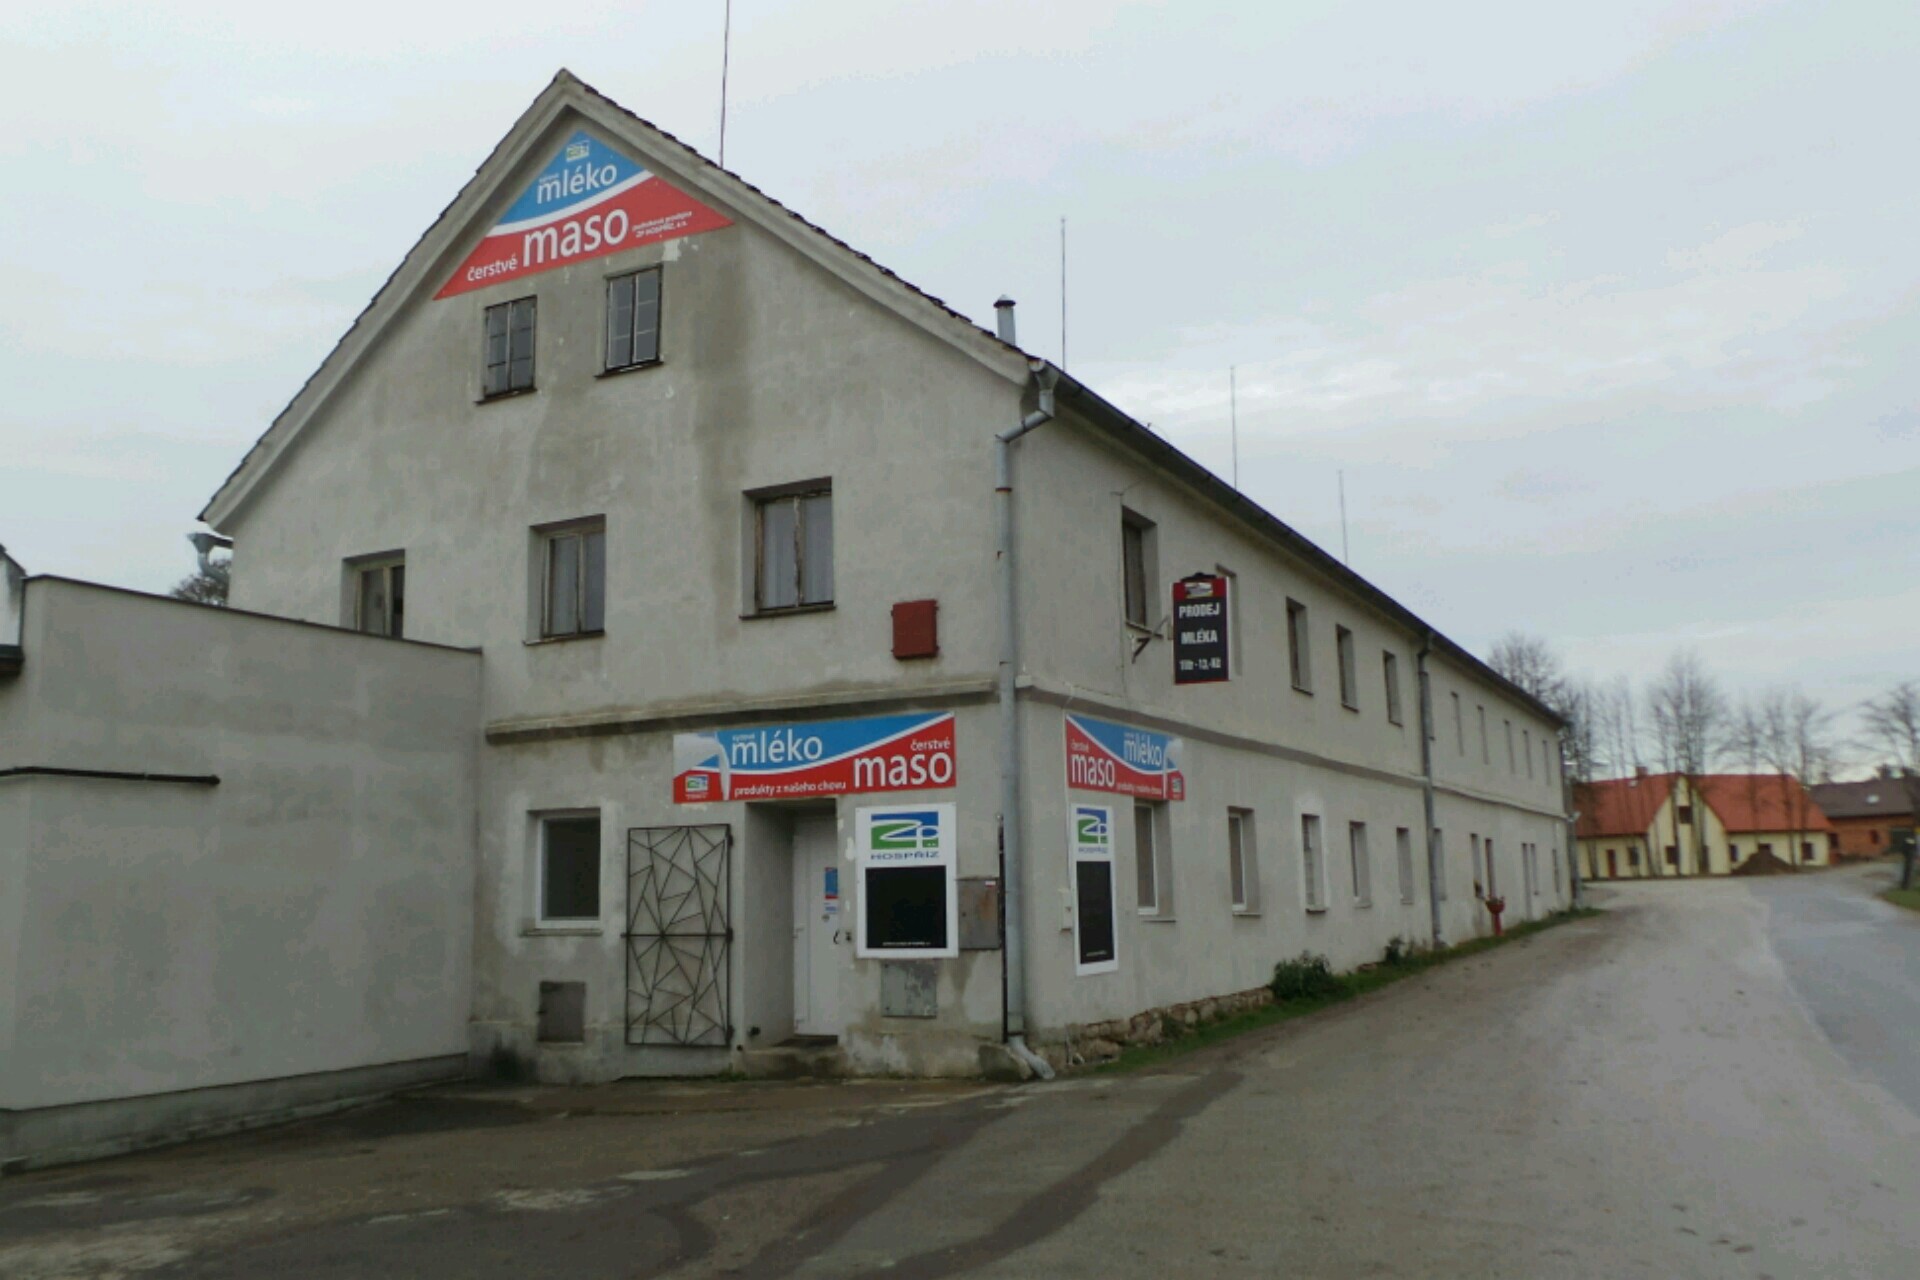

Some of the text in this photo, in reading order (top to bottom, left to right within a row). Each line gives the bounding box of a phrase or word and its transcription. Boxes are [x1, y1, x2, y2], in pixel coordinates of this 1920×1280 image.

[537, 161, 618, 204] mléko
[466, 253, 518, 282] čerstvé
[523, 208, 629, 267] maso
[1178, 602, 1220, 619] PRODEJ
[1180, 628, 1218, 645] MLÉKA
[731, 728, 823, 765] mléko
[910, 737, 951, 752] čerstvé
[1123, 733, 1162, 767] mléko
[854, 752, 952, 788] maso
[1071, 754, 1115, 788] maso
[734, 780, 847, 798] produkty z našeho chovu
